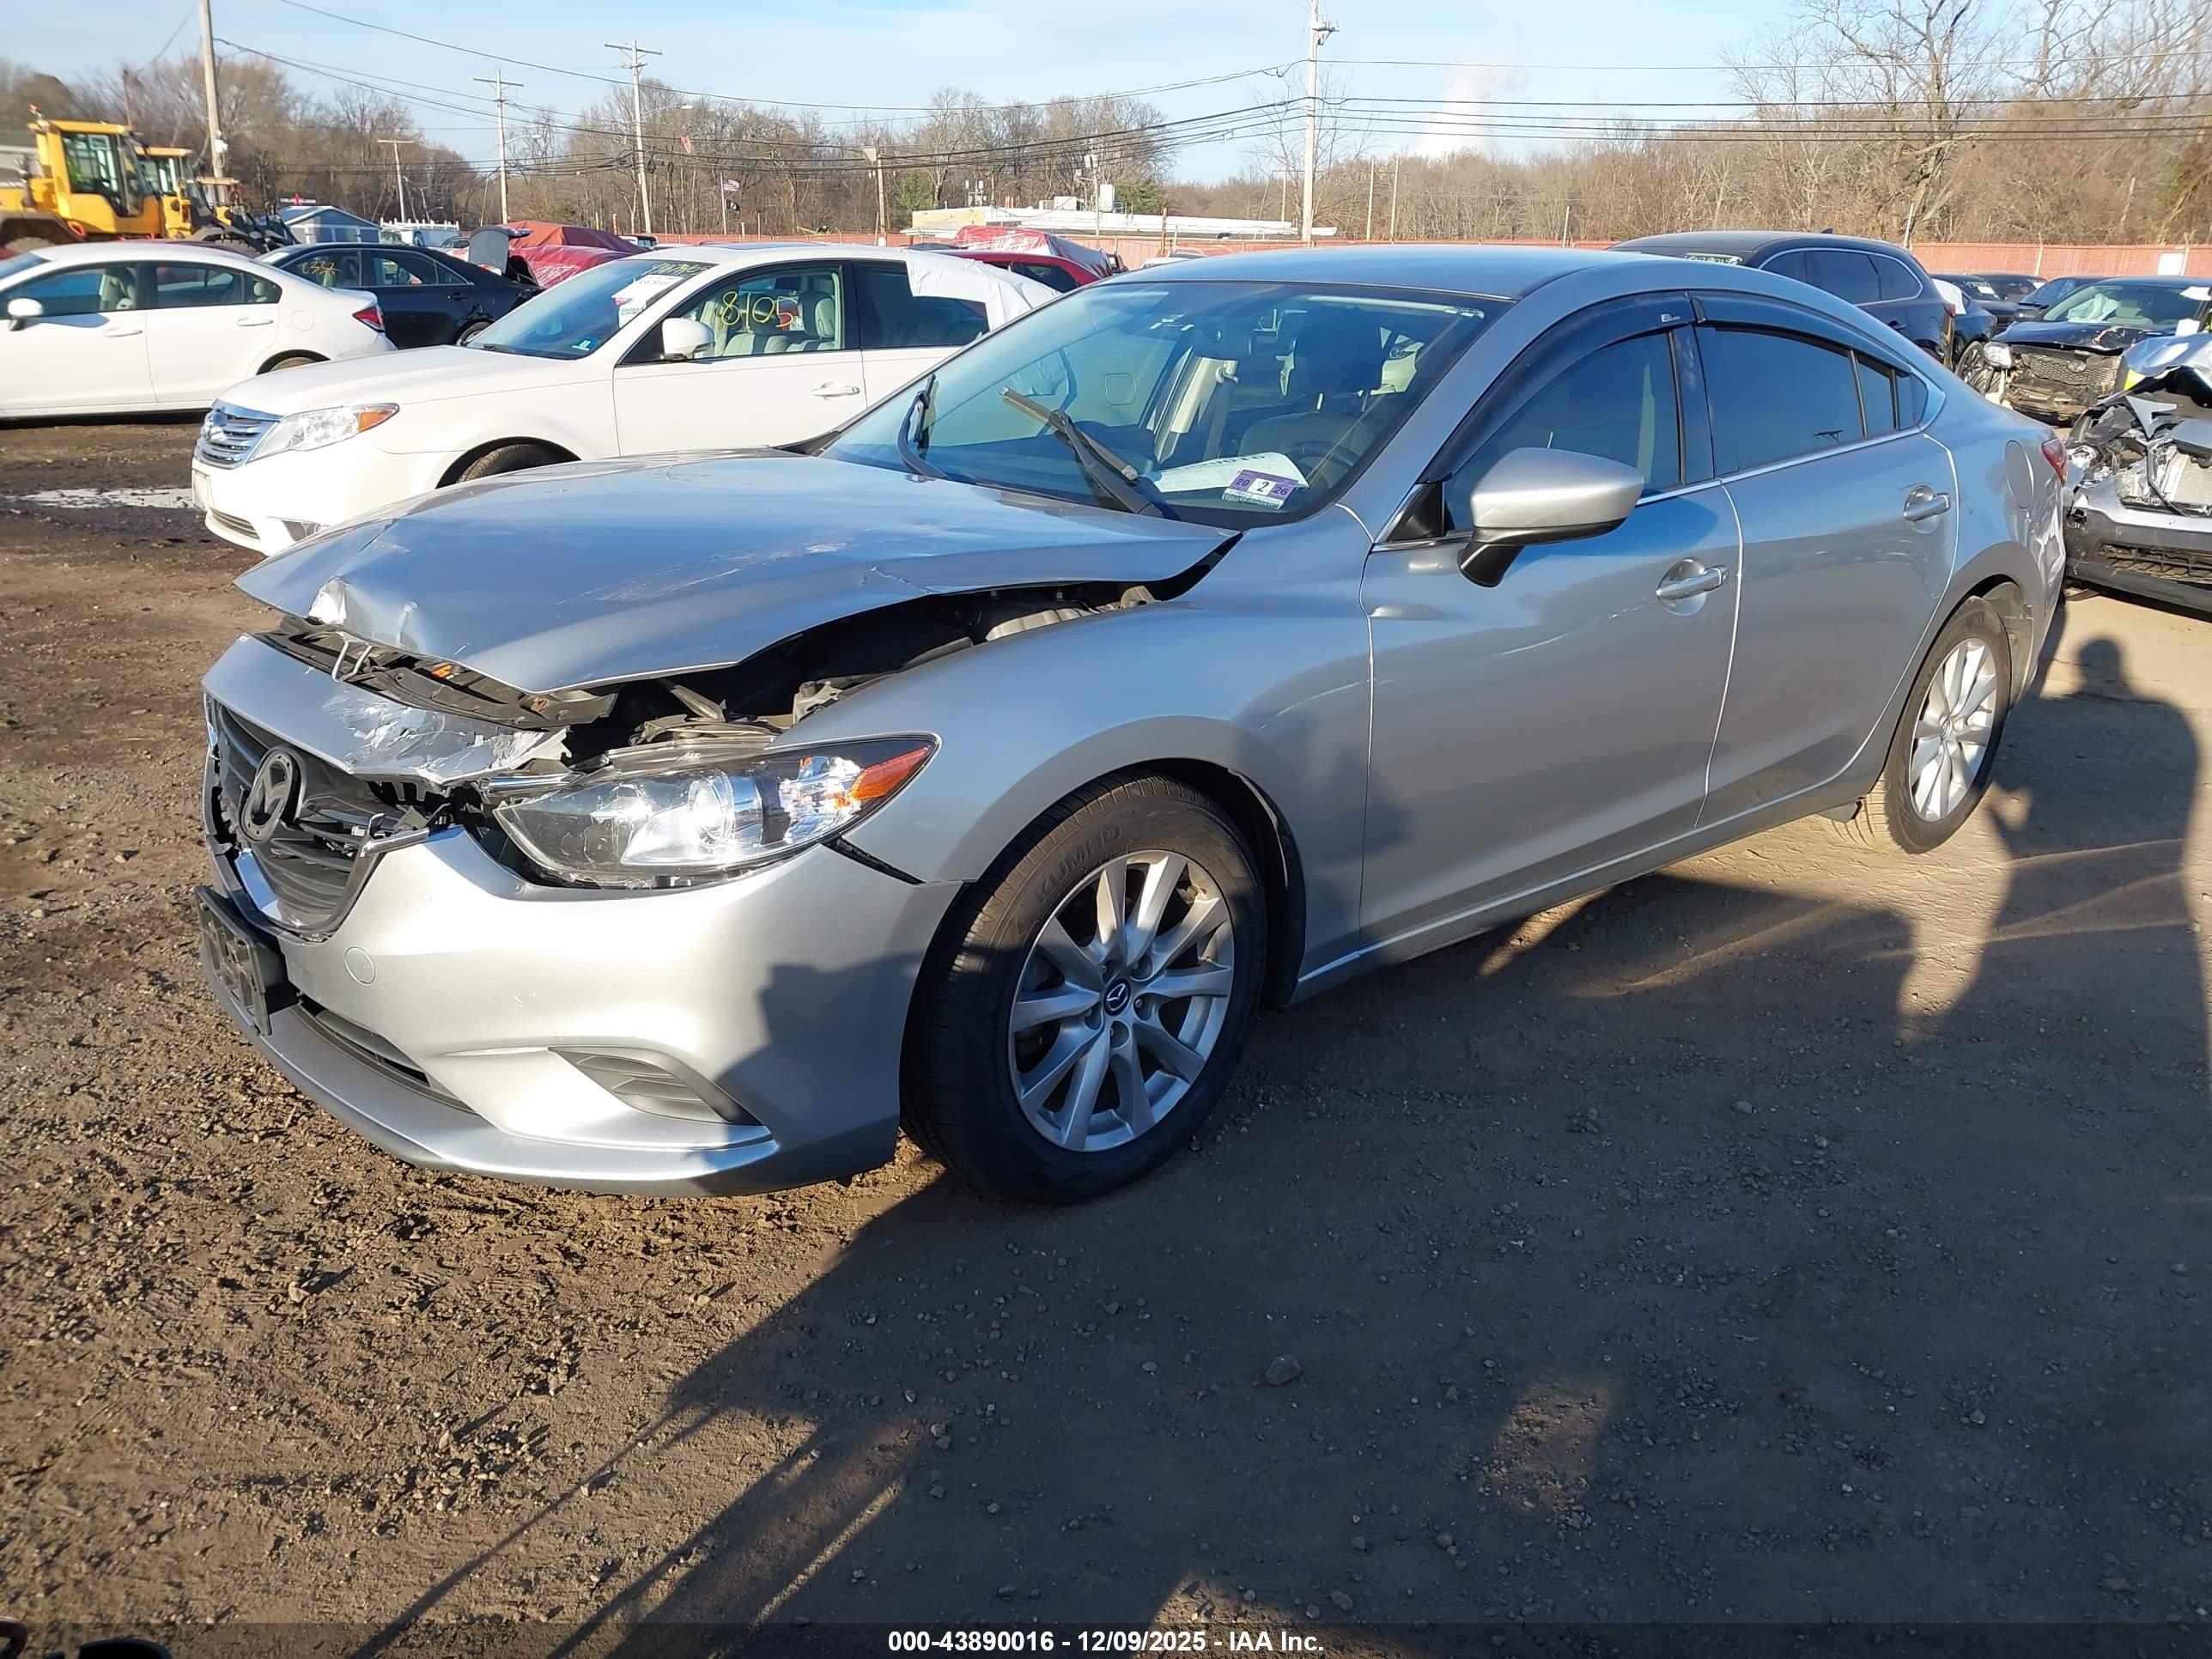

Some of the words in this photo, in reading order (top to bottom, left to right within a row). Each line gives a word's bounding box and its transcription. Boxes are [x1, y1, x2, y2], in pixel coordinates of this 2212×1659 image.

[721, 291, 799, 331] 8105
[1236, 478, 1250, 487] 20
[1256, 481, 1270, 493] 2
[1273, 486, 1290, 495] 26
[1035, 824, 1122, 903] KUMHO
